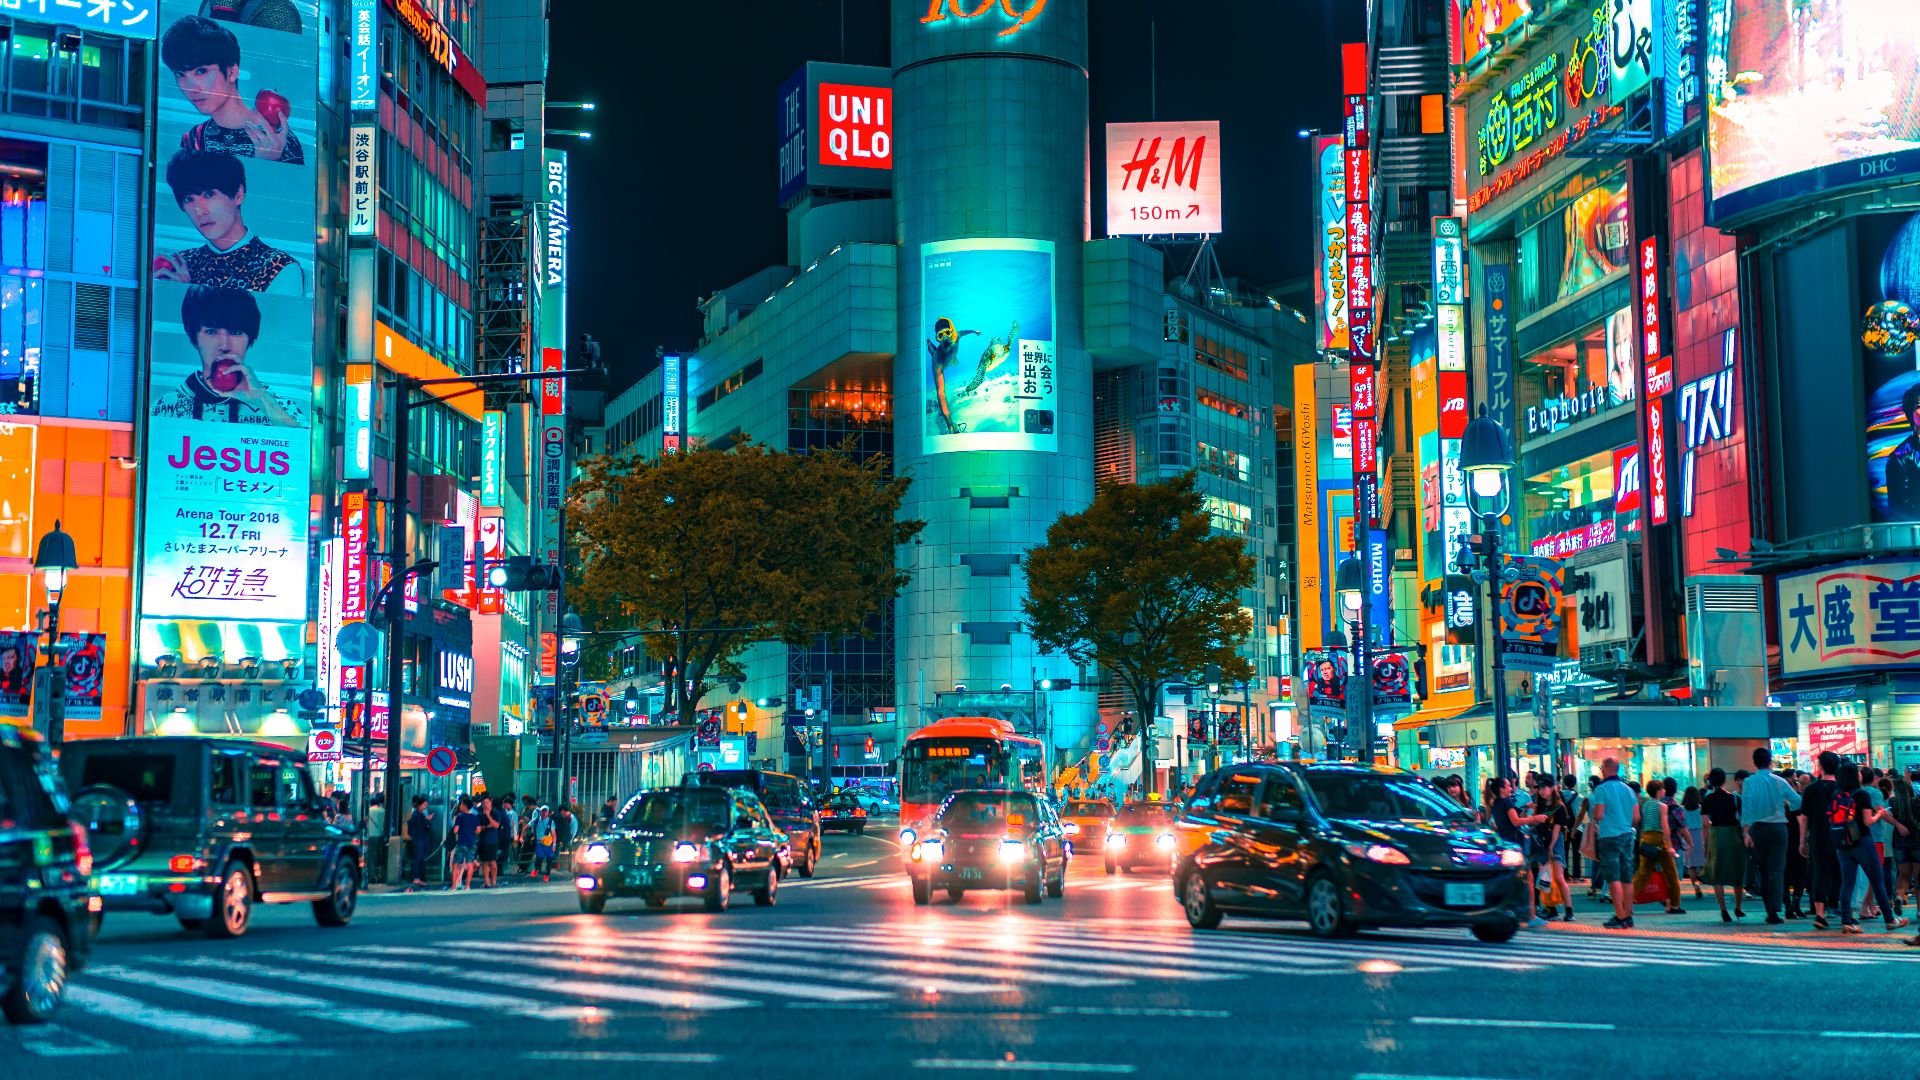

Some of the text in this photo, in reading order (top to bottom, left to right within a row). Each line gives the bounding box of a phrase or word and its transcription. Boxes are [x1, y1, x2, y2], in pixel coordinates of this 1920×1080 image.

[357, 10, 371, 99] 英会話イーオン
[430, 20, 458, 74] ガスト
[784, 87, 800, 130] THE
[828, 94, 884, 126] UNI
[1512, 75, 1557, 152] 西村
[780, 128, 805, 188] PRIME
[829, 128, 890, 161] QLO
[1121, 135, 1206, 192] H&M
[354, 134, 369, 226] 渋谷駅前ビル
[1860, 157, 1896, 177] DHC
[548, 161, 569, 285] BIC CAMERA
[1023, 352, 1052, 364] 世界に
[1024, 365, 1052, 379] 出会
[1024, 380, 1052, 394] おう
[1443, 398, 1465, 412] JTB
[1528, 384, 1605, 434] Euphoria
[168, 436, 290, 476] Jesus
[240, 437, 290, 447] NEW SINGLE
[1302, 402, 1312, 525] Matsumoto KiYoshi
[1446, 458, 1455, 490] パーラー
[176, 508, 279, 523] Arena Tour 2018
[199, 523, 261, 541] 12.7 FRI
[164, 542, 288, 557] さいたまスーパーアリーナ
[450, 532, 461, 585] 渋谷駅前
[1448, 526, 1457, 560] フルーツ
[1371, 543, 1383, 594] MIZUHO
[1455, 590, 1473, 627] HUB
[1789, 581, 1920, 654] 大盛堂
[1514, 644, 1543, 654] Tik Tok
[440, 651, 472, 692] LUSH
